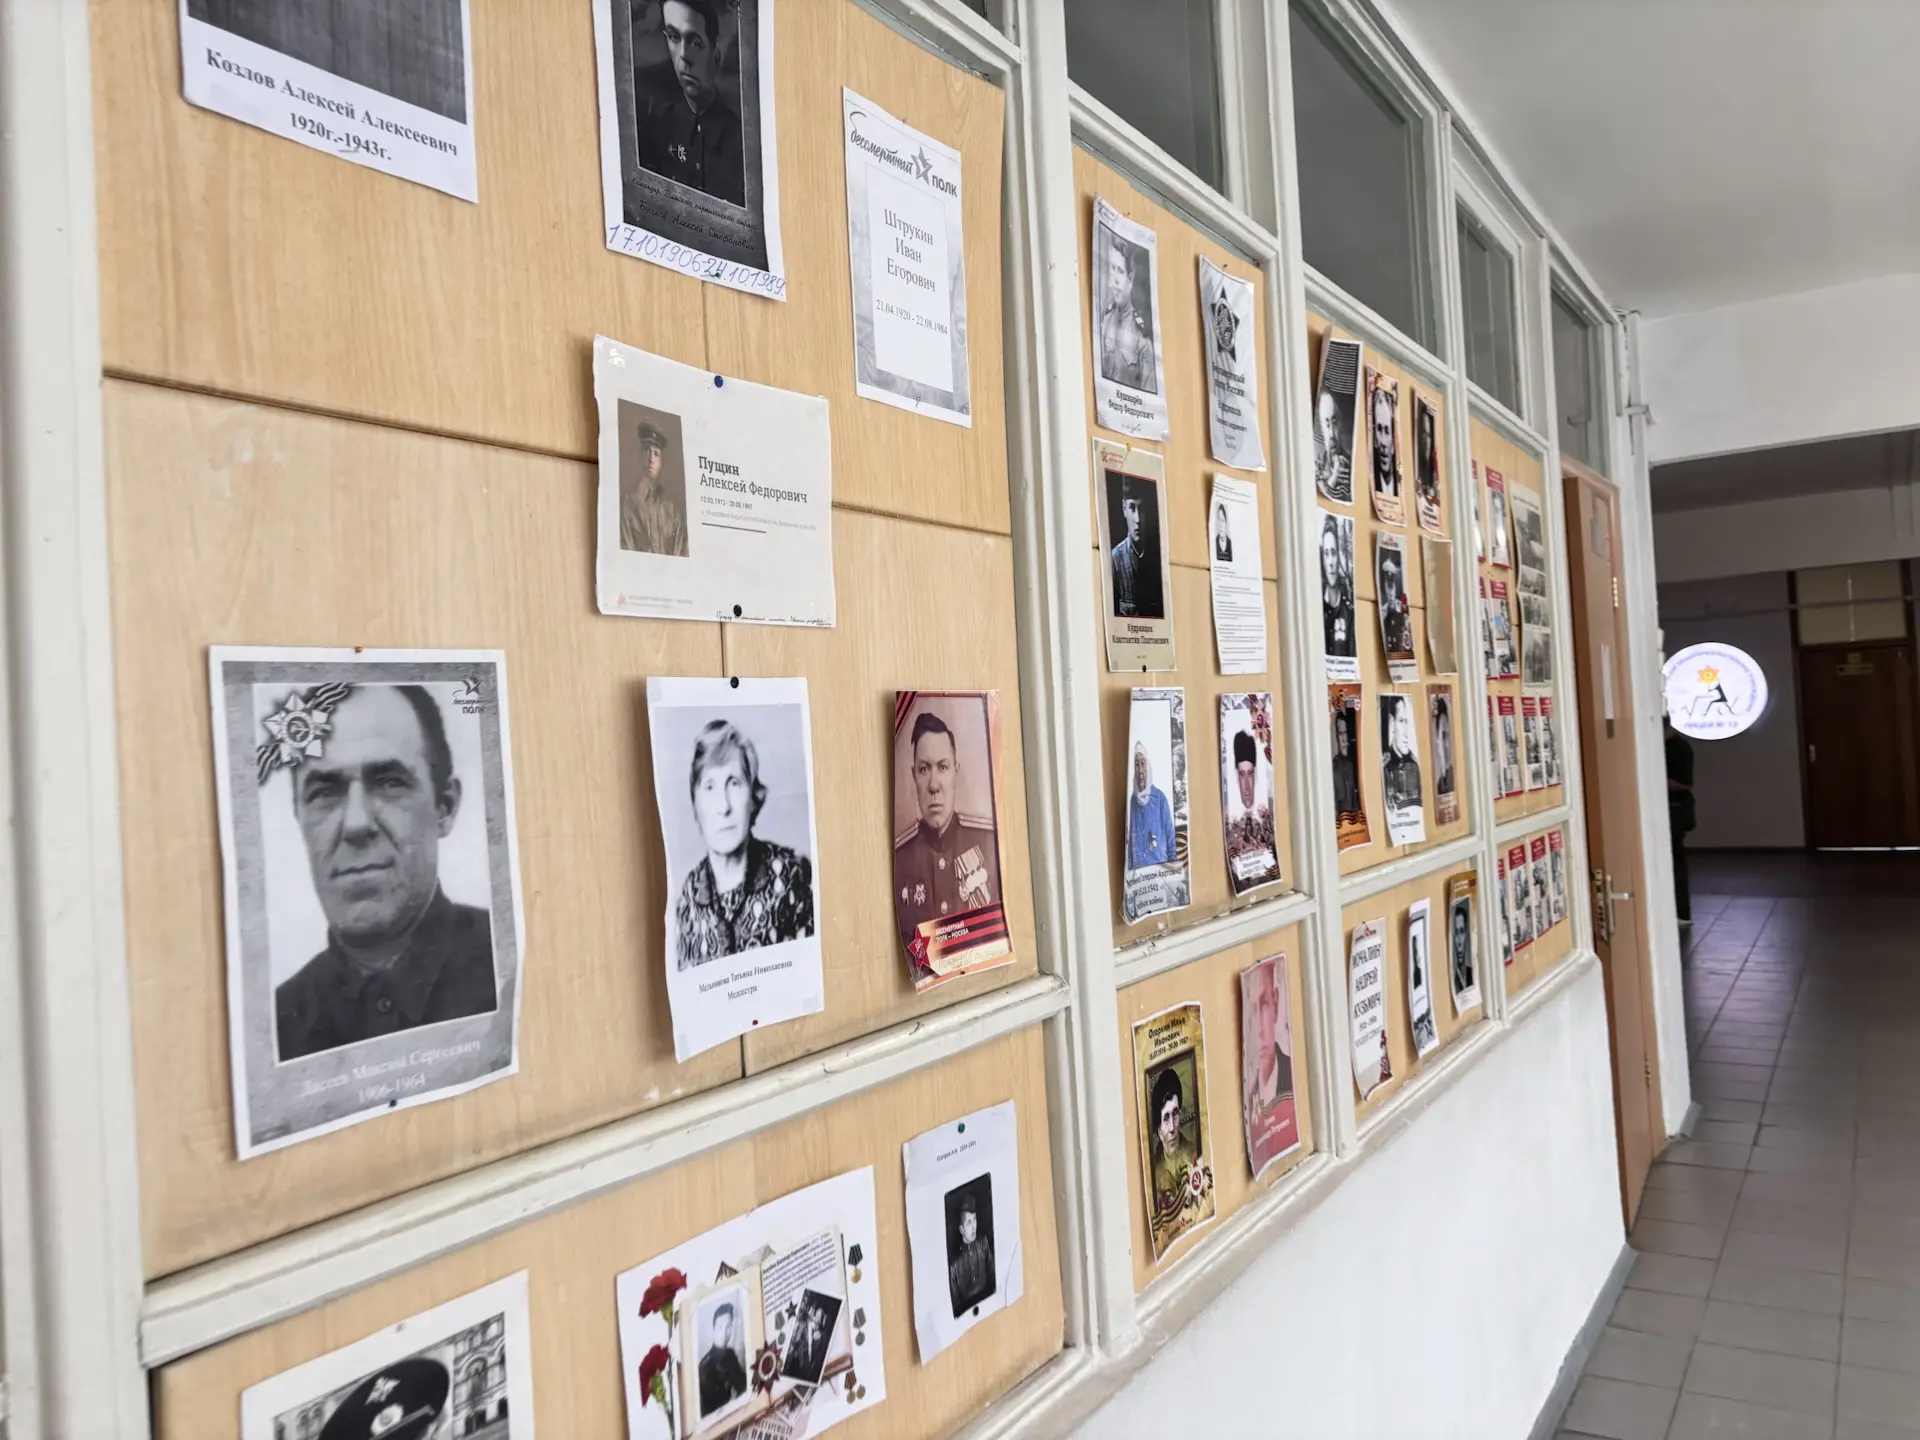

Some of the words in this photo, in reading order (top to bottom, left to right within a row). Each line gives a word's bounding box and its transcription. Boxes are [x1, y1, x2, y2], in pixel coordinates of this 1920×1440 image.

[205, 48, 276, 89] Козлов
[280, 79, 356, 121] Алексей
[360, 109, 459, 157] Алексеевич
[289, 112, 393, 161] 1920г.-1943г.
[883, 208, 934, 246] Штрукин
[895, 237, 922, 264] Иван
[886, 257, 936, 293] Егорович
[697, 455, 740, 476] Пущин
[699, 472, 747, 493] Алексей
[748, 481, 808, 503] Федорович
